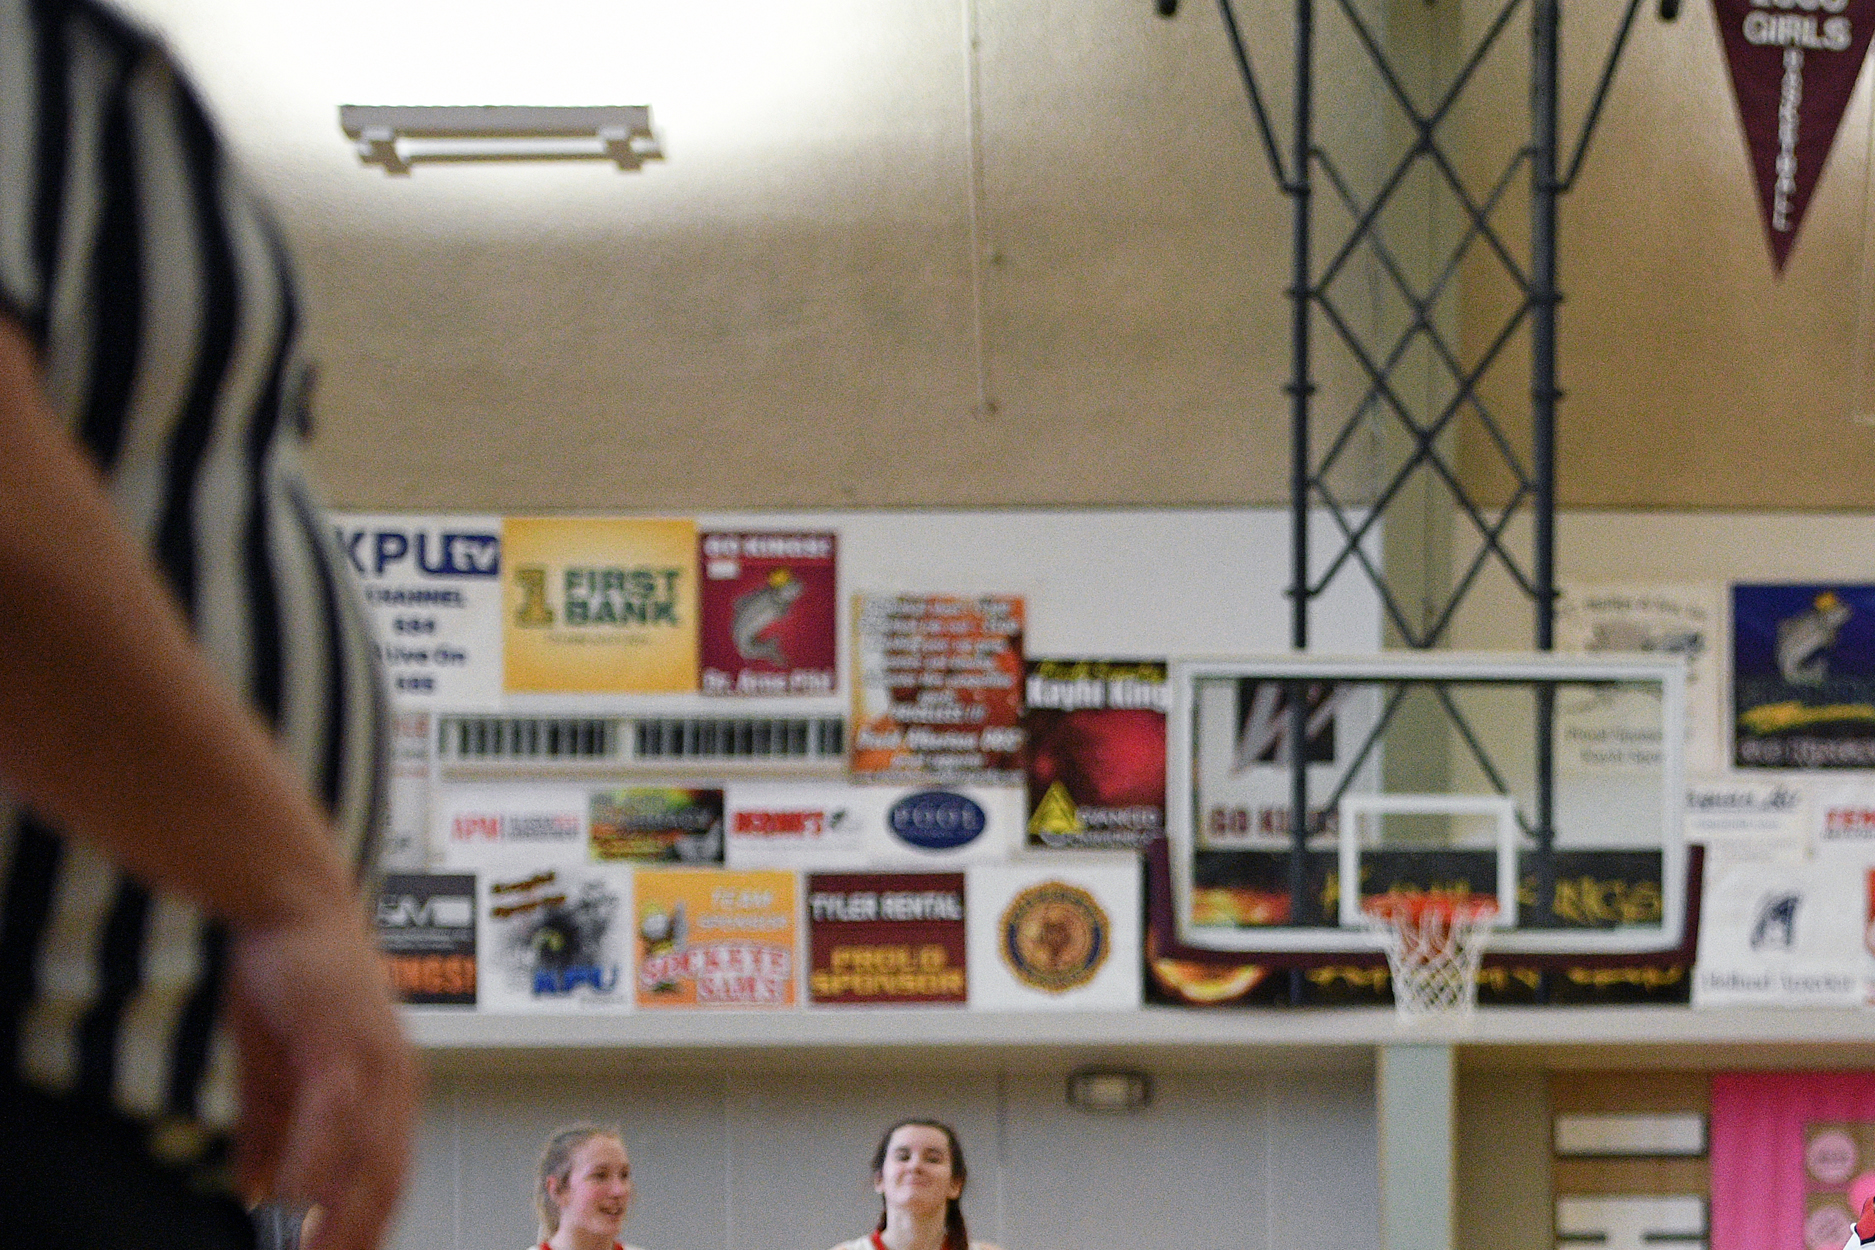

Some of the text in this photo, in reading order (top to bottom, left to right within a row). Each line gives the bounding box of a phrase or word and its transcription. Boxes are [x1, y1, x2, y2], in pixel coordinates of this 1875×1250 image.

[1742, 15, 1852, 51] GIRLS
[564, 567, 684, 597] FIRST
[564, 598, 683, 628] BANK
[812, 893, 877, 921] TYLER
